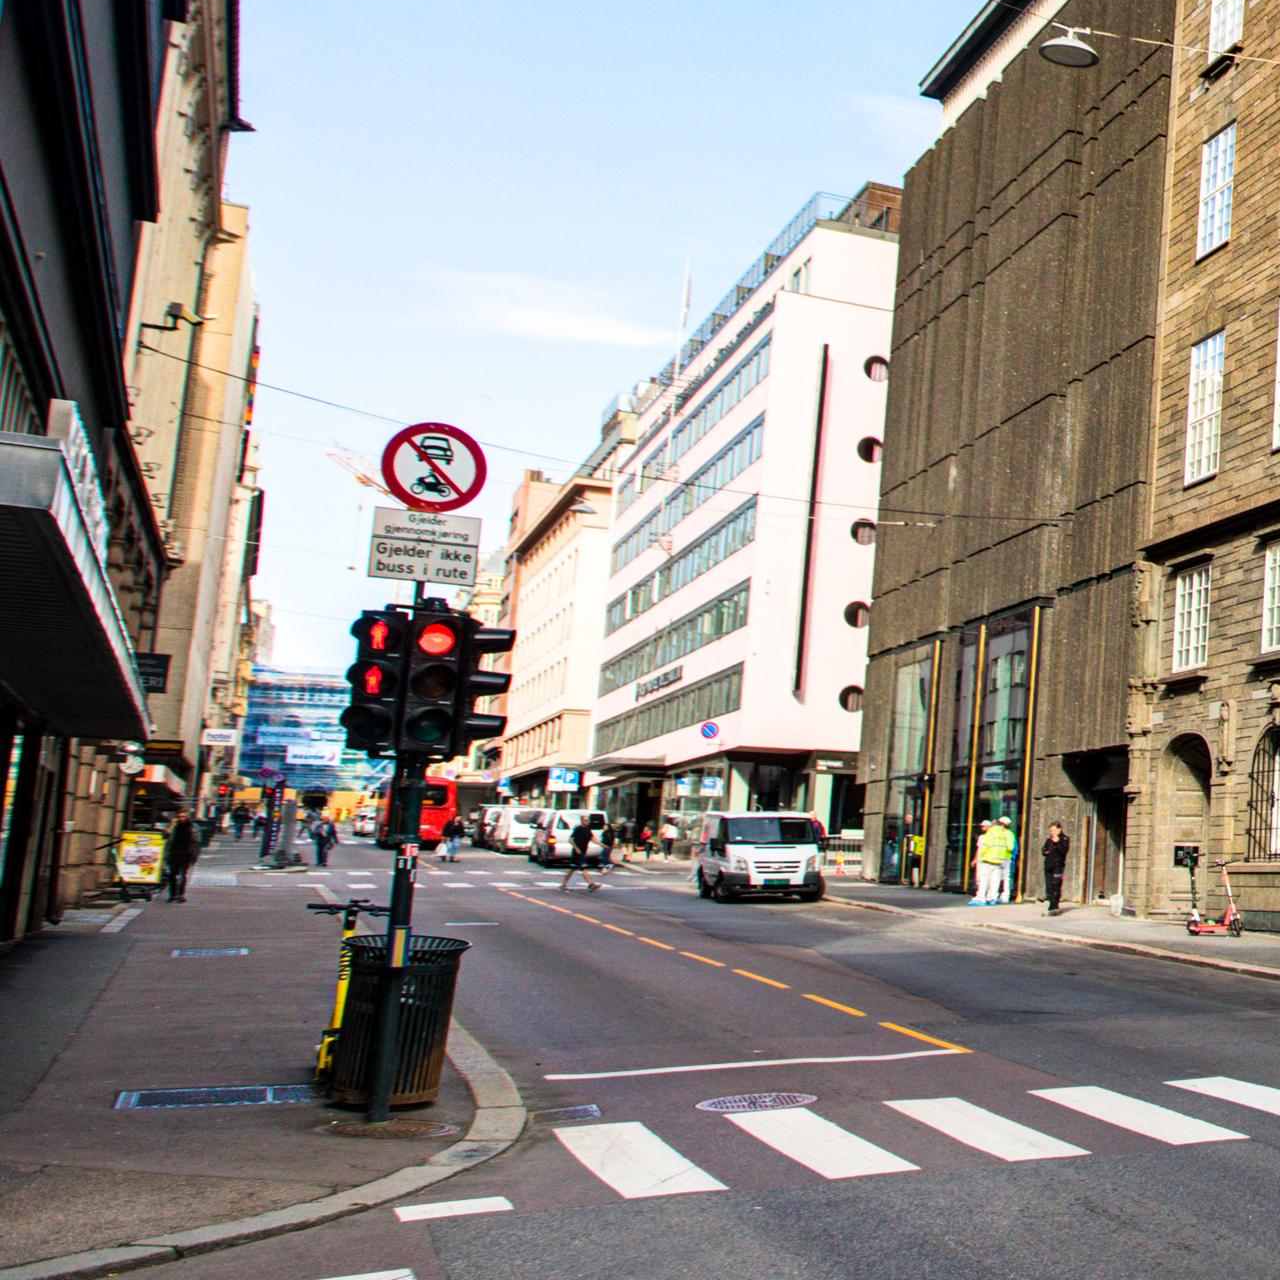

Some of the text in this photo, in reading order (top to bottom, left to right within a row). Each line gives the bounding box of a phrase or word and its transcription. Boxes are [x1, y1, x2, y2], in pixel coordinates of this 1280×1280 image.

[408, 513, 448, 526] Gjelder
[376, 542, 472, 563] Gjelder ikke
[375, 558, 468, 579] buss i rute
[565, 772, 575, 784] P
